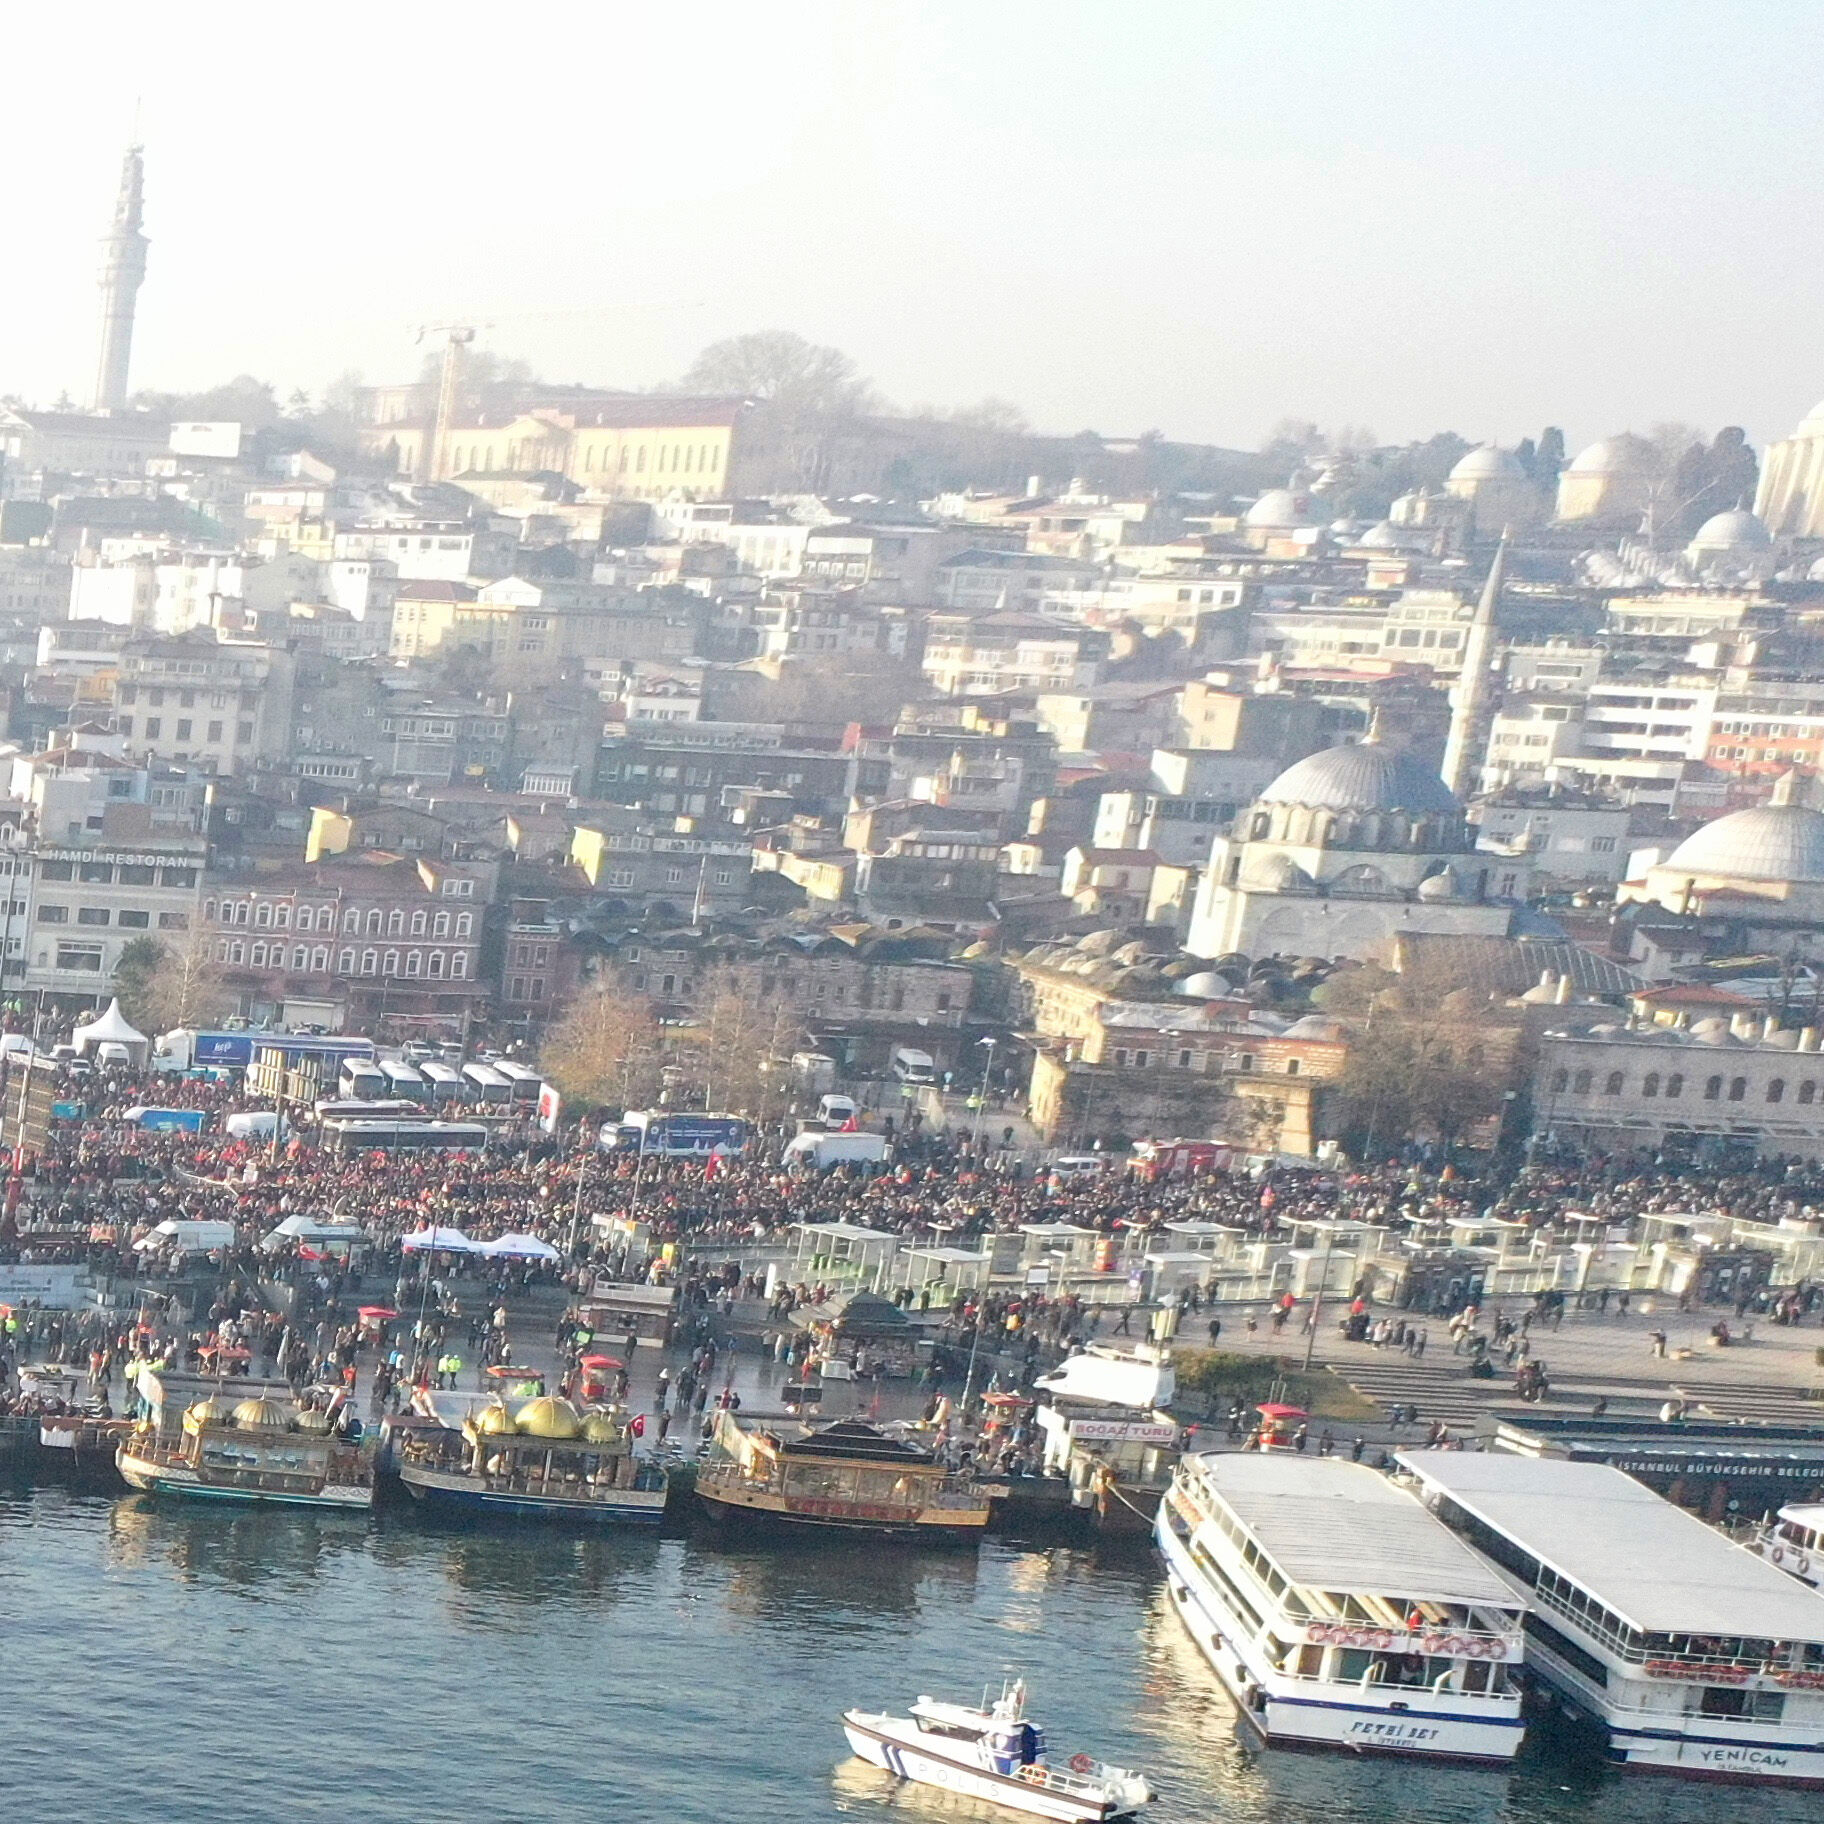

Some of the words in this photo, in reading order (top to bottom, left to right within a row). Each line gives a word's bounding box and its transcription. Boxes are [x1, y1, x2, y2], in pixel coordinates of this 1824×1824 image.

[48, 848, 97, 863] HAMDİ
[105, 853, 188, 868] RESTORAN
[1133, 1427, 1173, 1437] TURU
